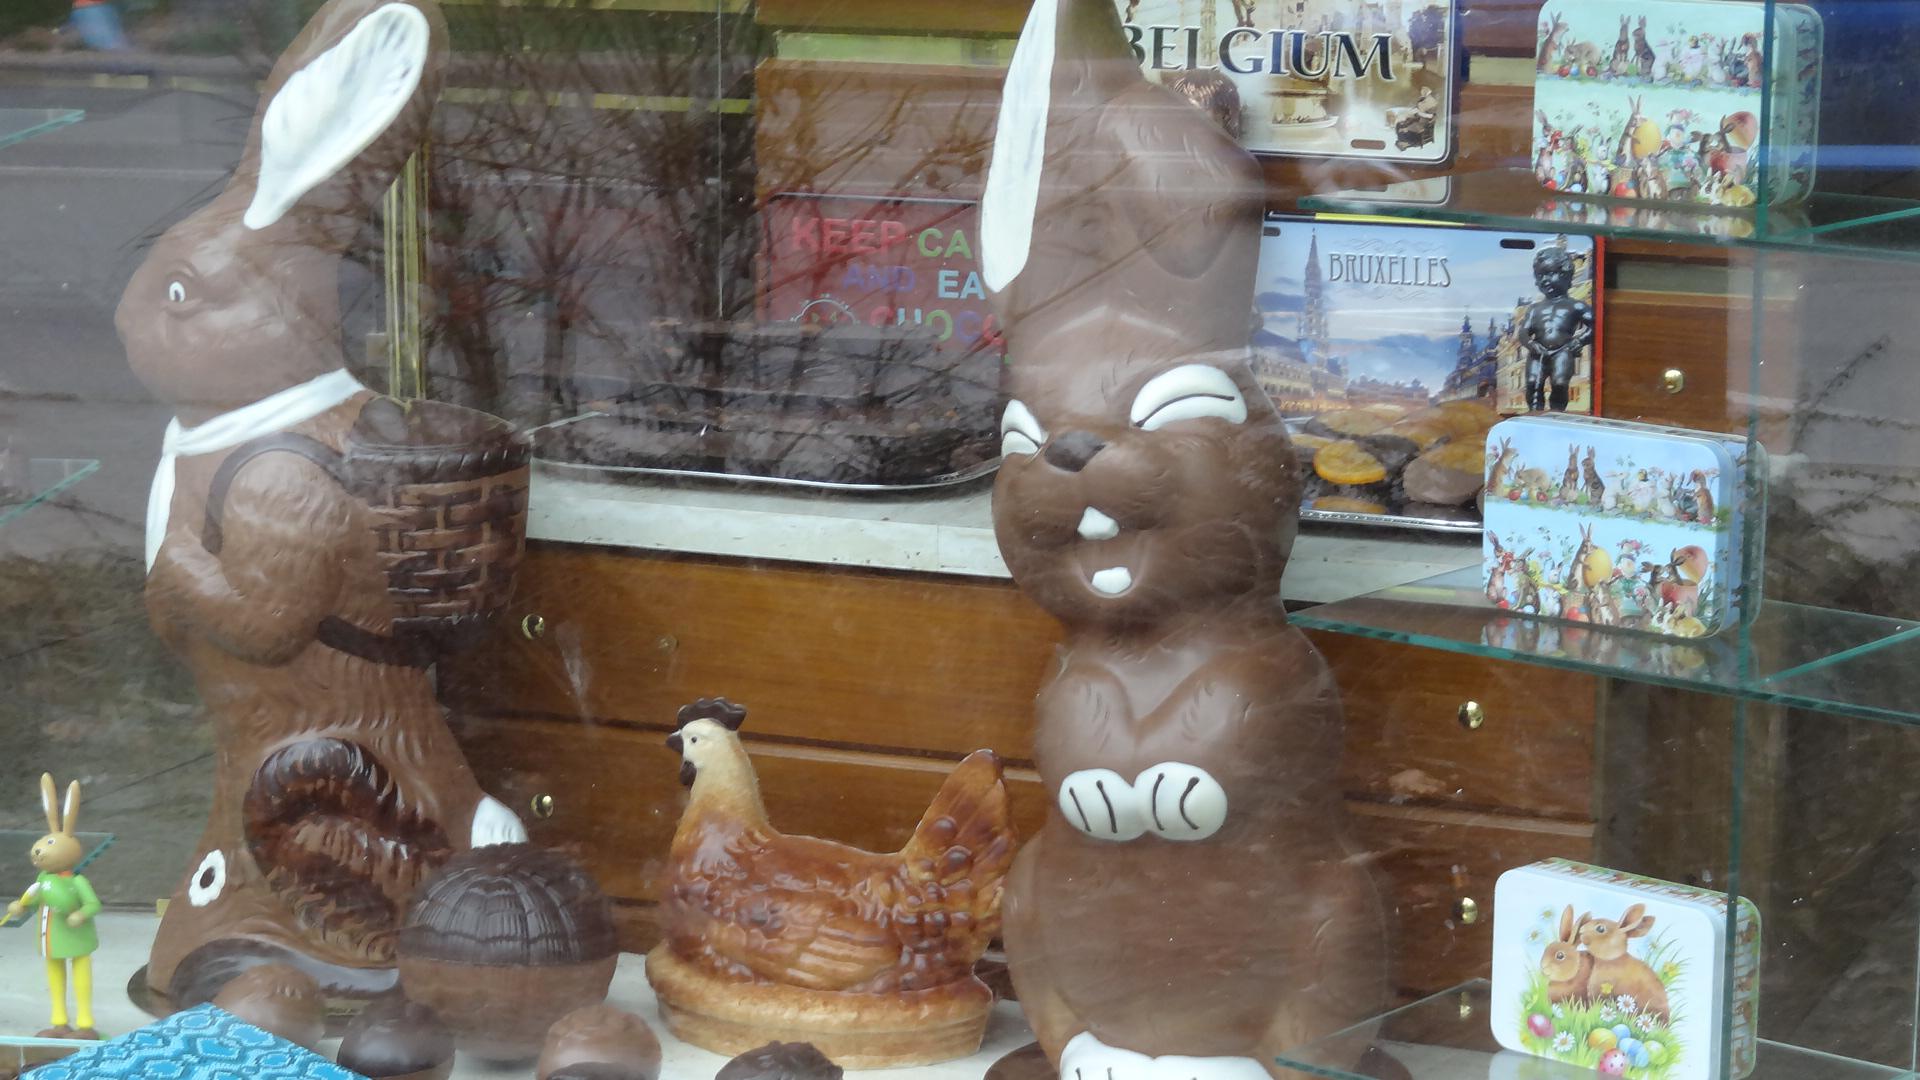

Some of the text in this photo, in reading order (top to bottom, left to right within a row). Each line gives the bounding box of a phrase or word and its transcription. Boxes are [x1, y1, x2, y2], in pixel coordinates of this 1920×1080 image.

[1124, 24, 1395, 81] BELGIUM
[791, 216, 973, 259] KEEP CA
[842, 265, 986, 300] AND EA
[1328, 253, 1450, 288] BRUXELLES
